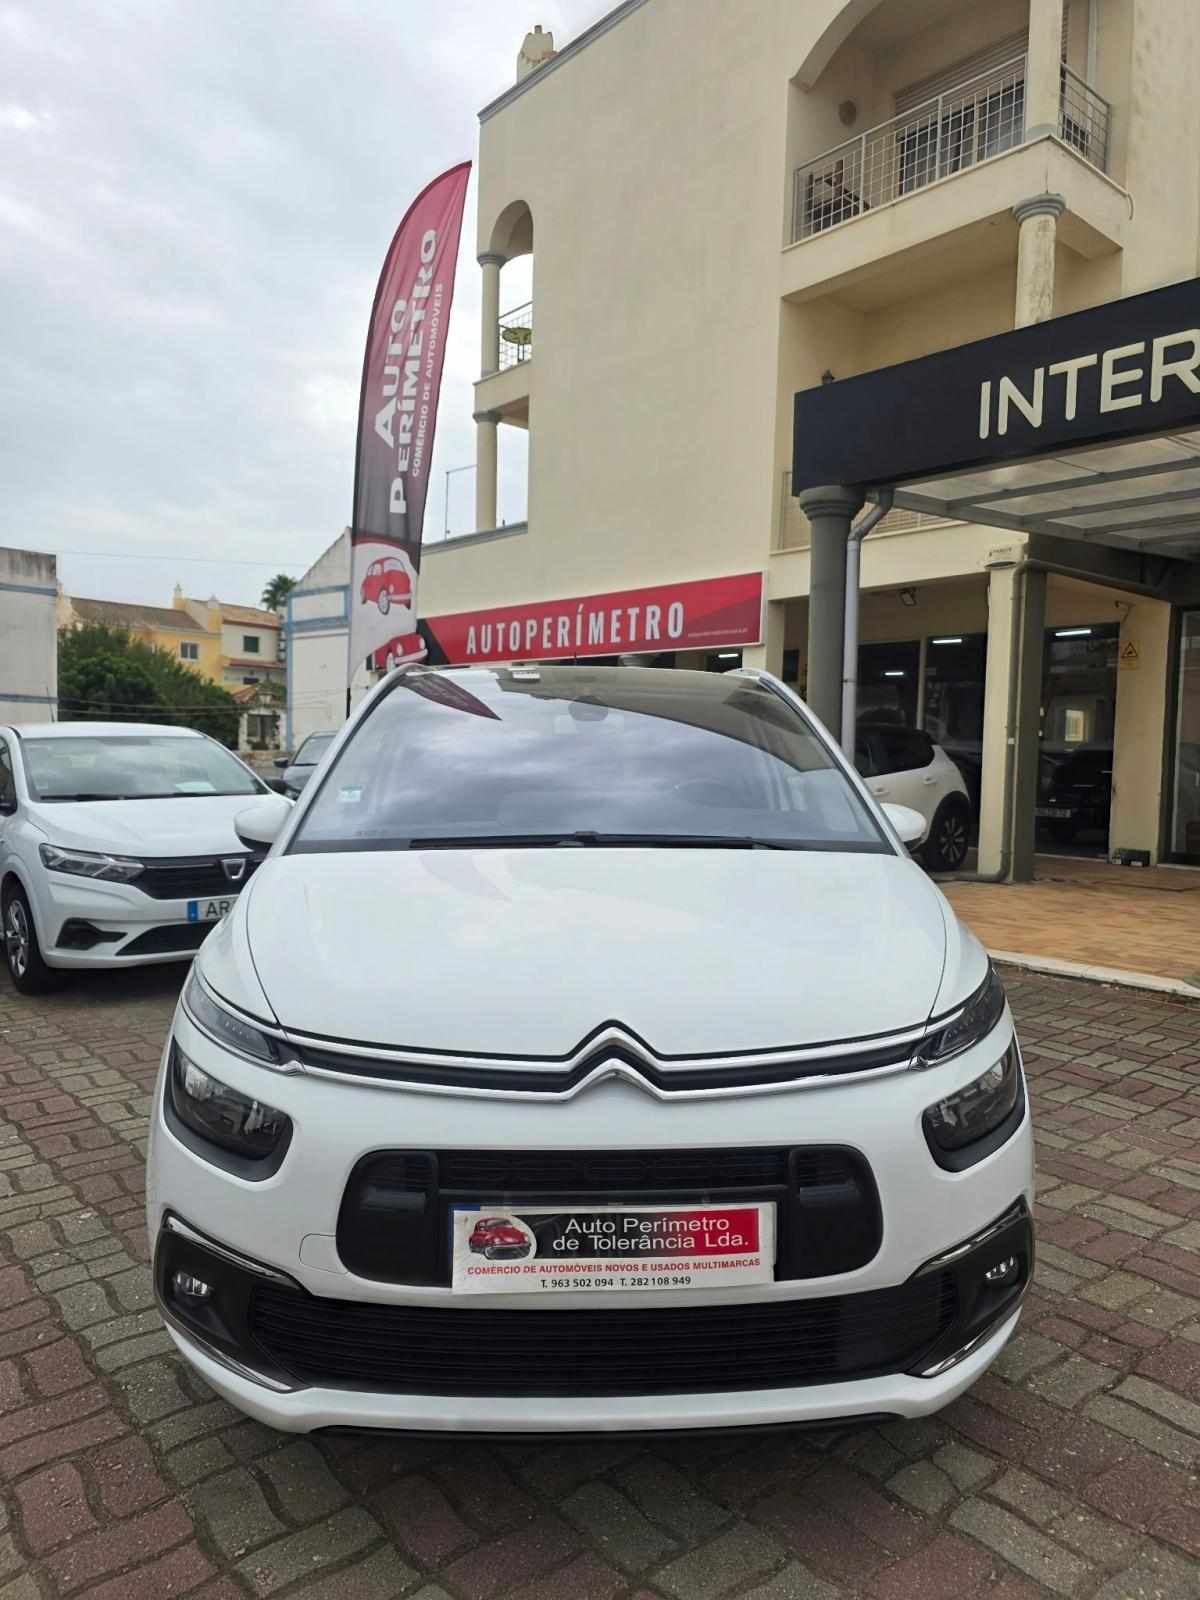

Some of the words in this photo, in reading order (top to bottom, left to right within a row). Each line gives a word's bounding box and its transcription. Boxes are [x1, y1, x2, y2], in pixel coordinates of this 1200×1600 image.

[375, 299, 407, 448] AUTO
[422, 383, 431, 401] DE
[979, 328, 1200, 440] INTER
[466, 601, 685, 655] AUTOPERÍMETRO
[206, 901, 236, 918] AR
[565, 1218, 616, 1234] Auto
[623, 1217, 729, 1233] Perímetro
[553, 1236, 579, 1250] de
[588, 1234, 695, 1250] Tolerância
[705, 1232, 749, 1247] Lda.
[524, 1265, 537, 1273] DE
[539, 1263, 602, 1273] AUTOMÓVEIS
[605, 1263, 639, 1272] NOVOS
[642, 1263, 648, 1271] E
[650, 1262, 690, 1271] USADOS
[692, 1258, 760, 1270] MULTIMARCAS
[541, 1280, 548, 1288] T.
[551, 1279, 570, 1288] 963
[573, 1279, 591, 1287] 502
[595, 1278, 614, 1287] 094
[620, 1278, 628, 1287] T.
[631, 1277, 649, 1286] 282
[652, 1276, 669, 1285] 108
[672, 1276, 691, 1285] 949
